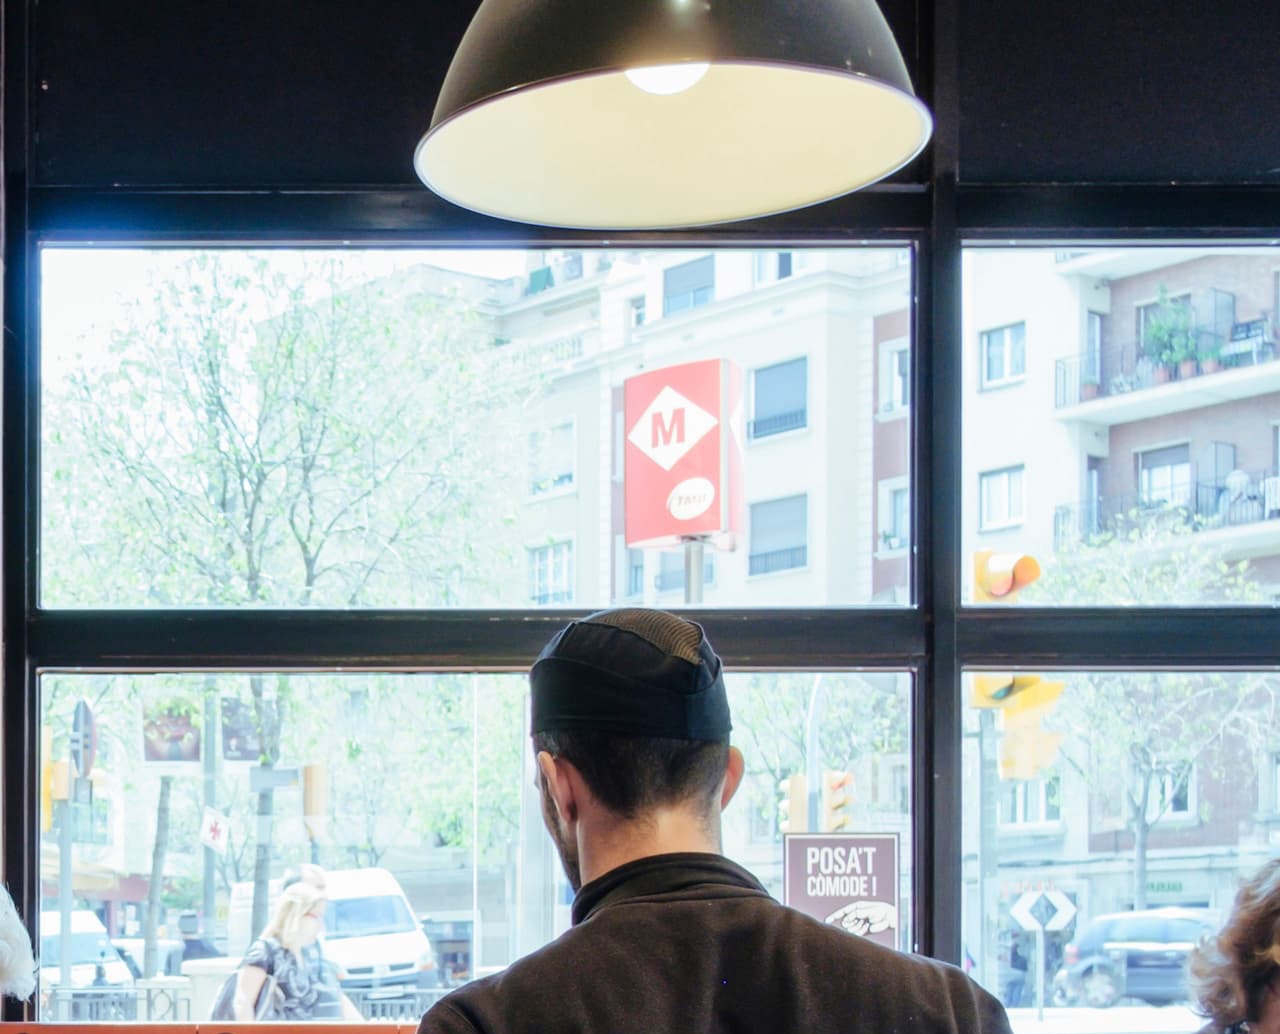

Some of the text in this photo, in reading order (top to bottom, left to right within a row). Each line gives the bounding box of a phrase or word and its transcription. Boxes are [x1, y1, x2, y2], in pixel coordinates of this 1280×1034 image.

[651, 407, 686, 449] M
[806, 846, 877, 875] POSA'T
[807, 872, 868, 897] CÒMODE
